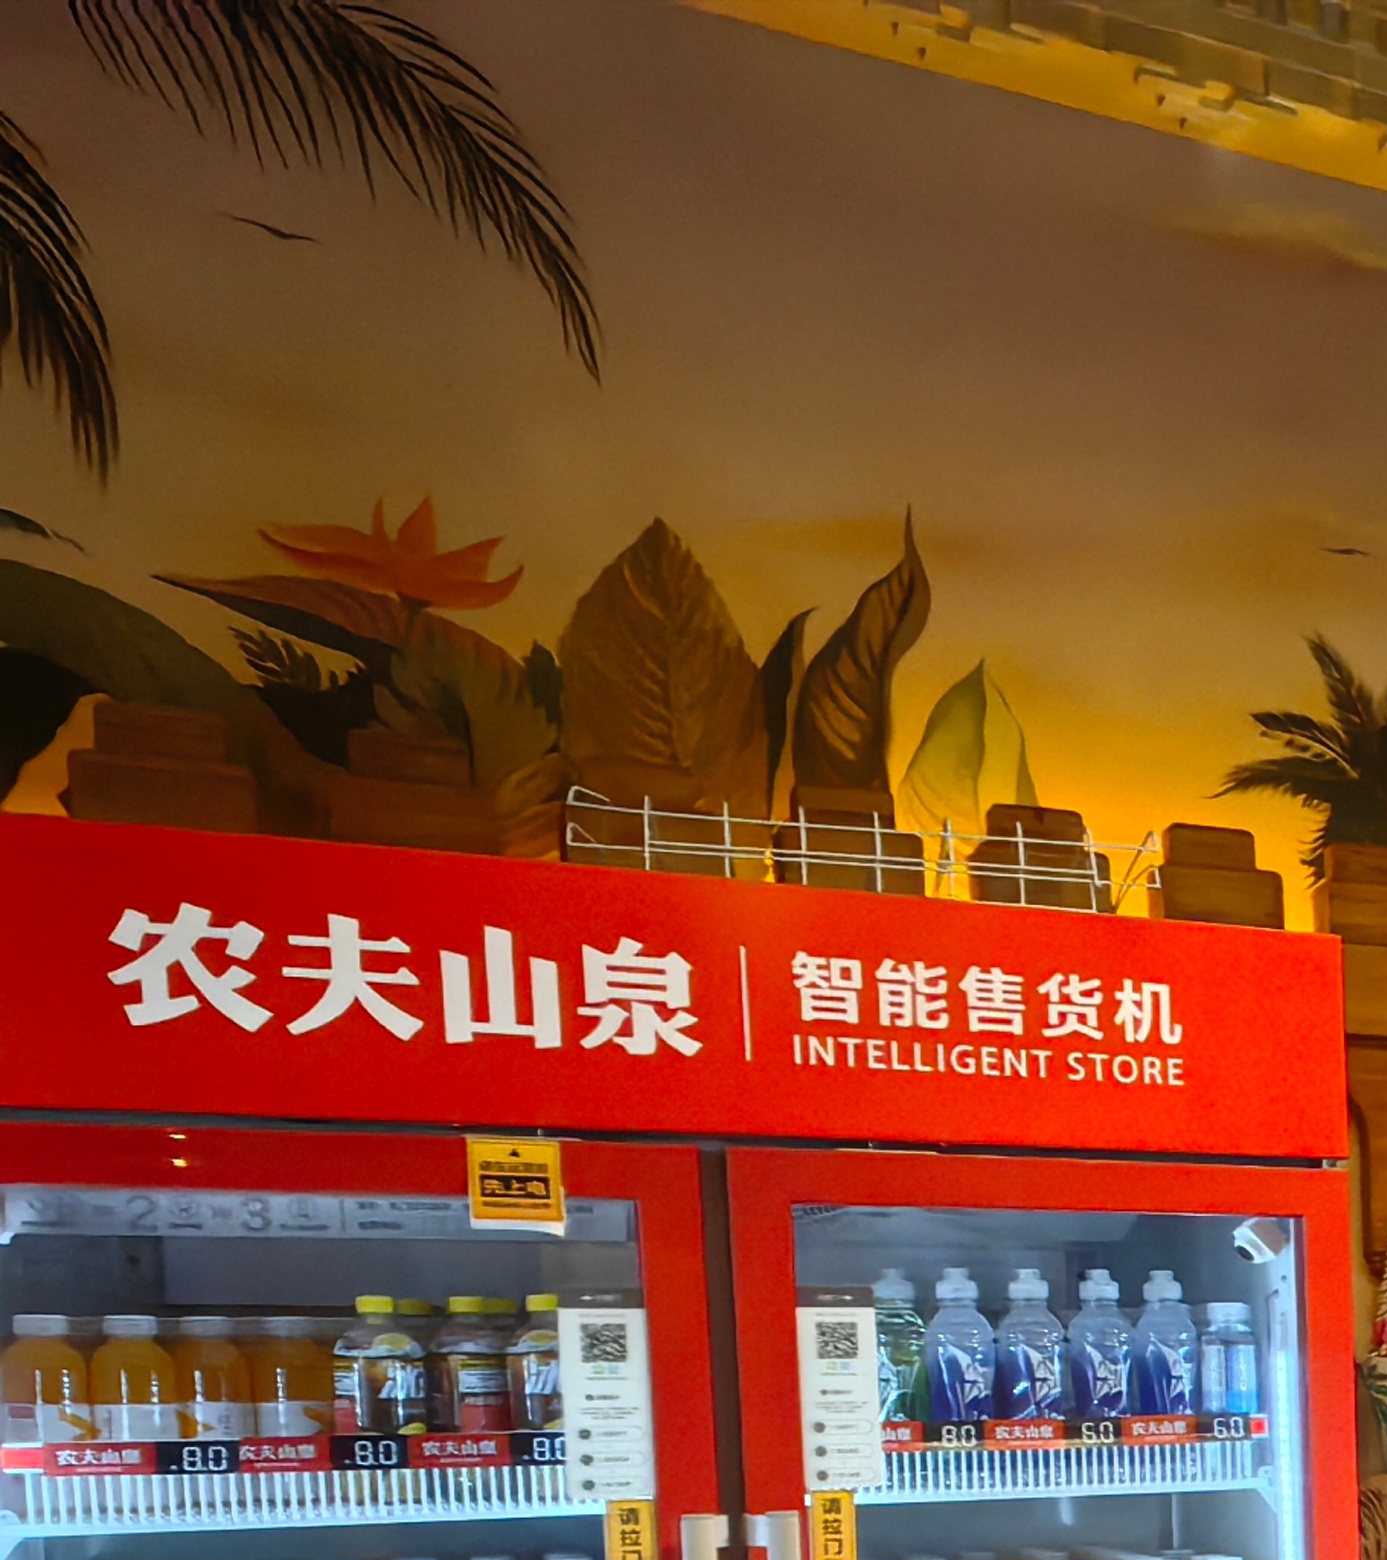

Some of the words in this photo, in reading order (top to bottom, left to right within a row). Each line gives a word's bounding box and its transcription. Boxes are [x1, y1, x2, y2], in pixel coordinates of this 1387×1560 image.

[107, 902, 703, 1056] 农夫山泉
[792, 952, 1183, 1046] 智能售货机
[792, 1033, 1050, 1080] INTELLIGENT
[1066, 1052, 1185, 1086] STORE
